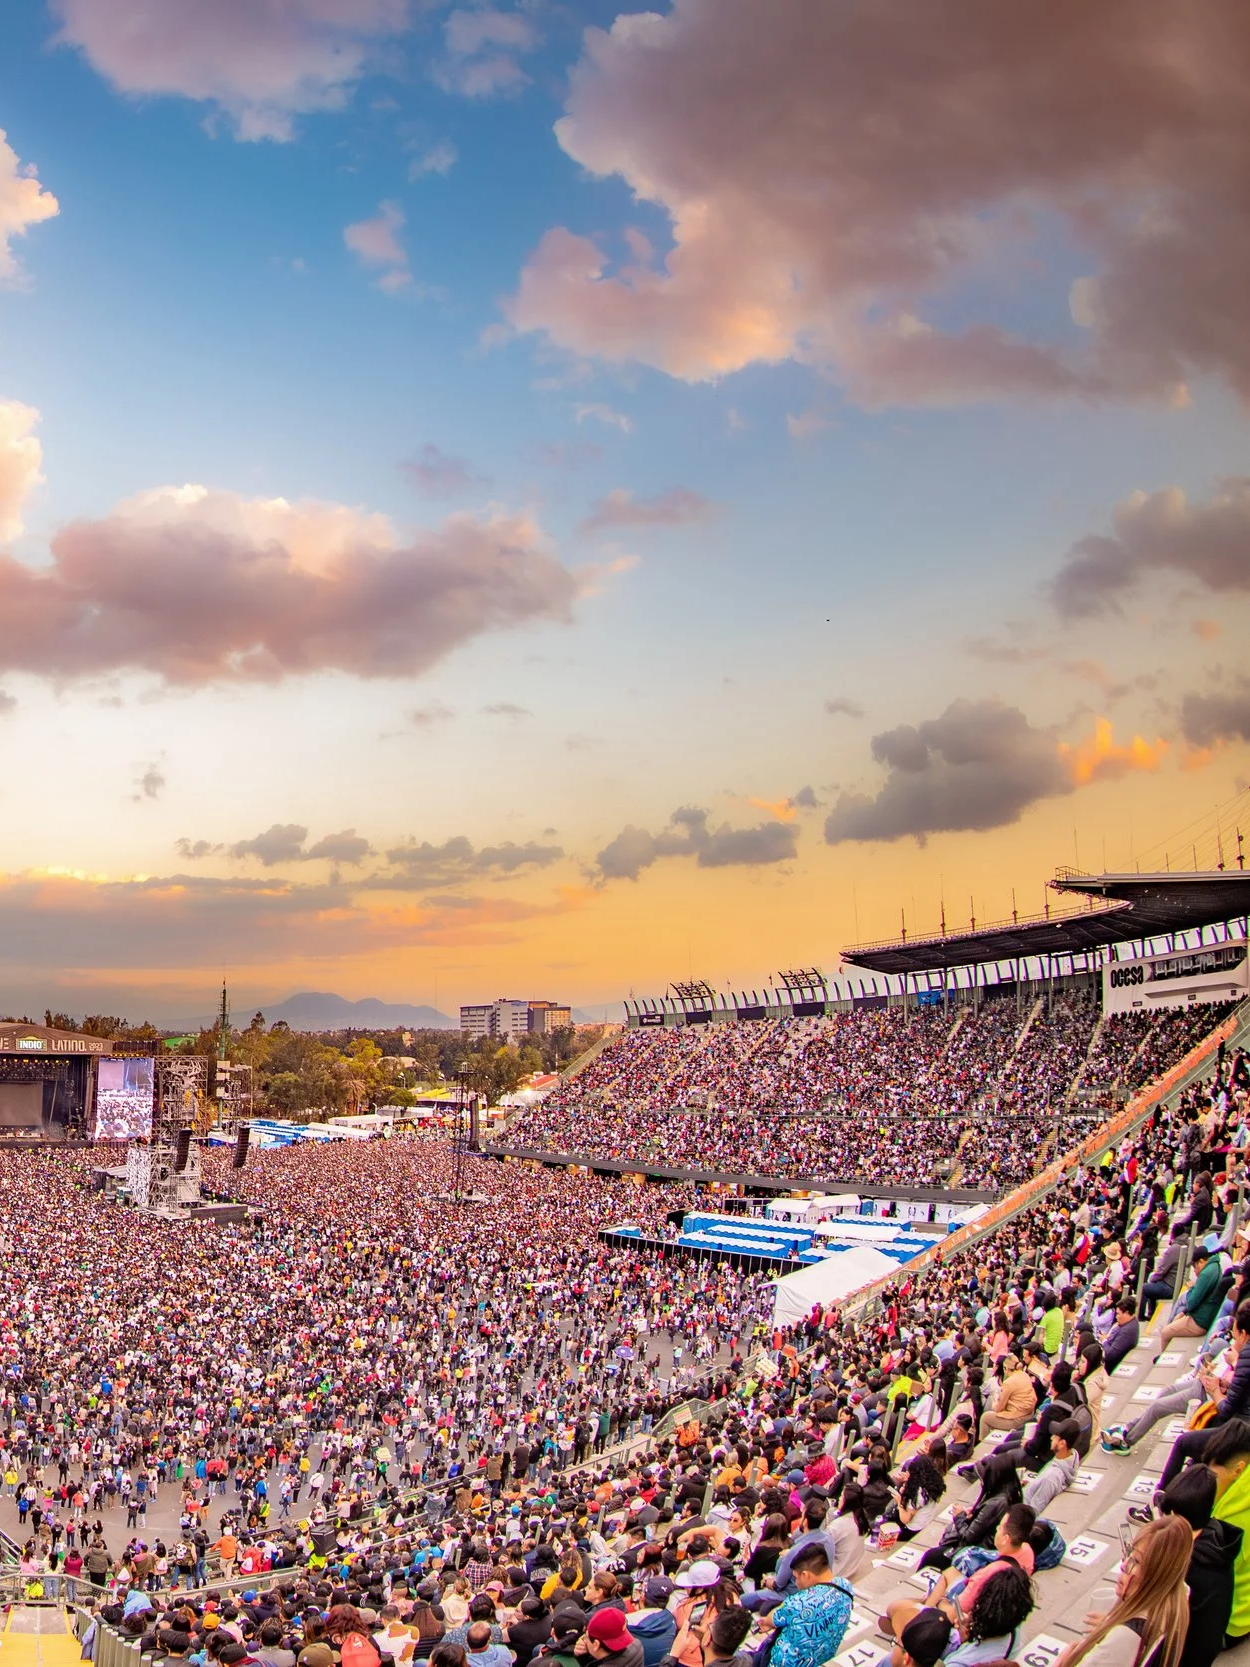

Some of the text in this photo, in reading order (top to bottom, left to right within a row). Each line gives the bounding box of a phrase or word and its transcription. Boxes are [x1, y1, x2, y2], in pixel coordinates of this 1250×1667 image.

[19, 1040, 43, 1049] INDIO
[1134, 1481, 1156, 1494] 13
[894, 1550, 915, 1563] 11
[1070, 1540, 1096, 1558] 15
[848, 1649, 874, 1667] 17
[1024, 1644, 1060, 1667] 19
